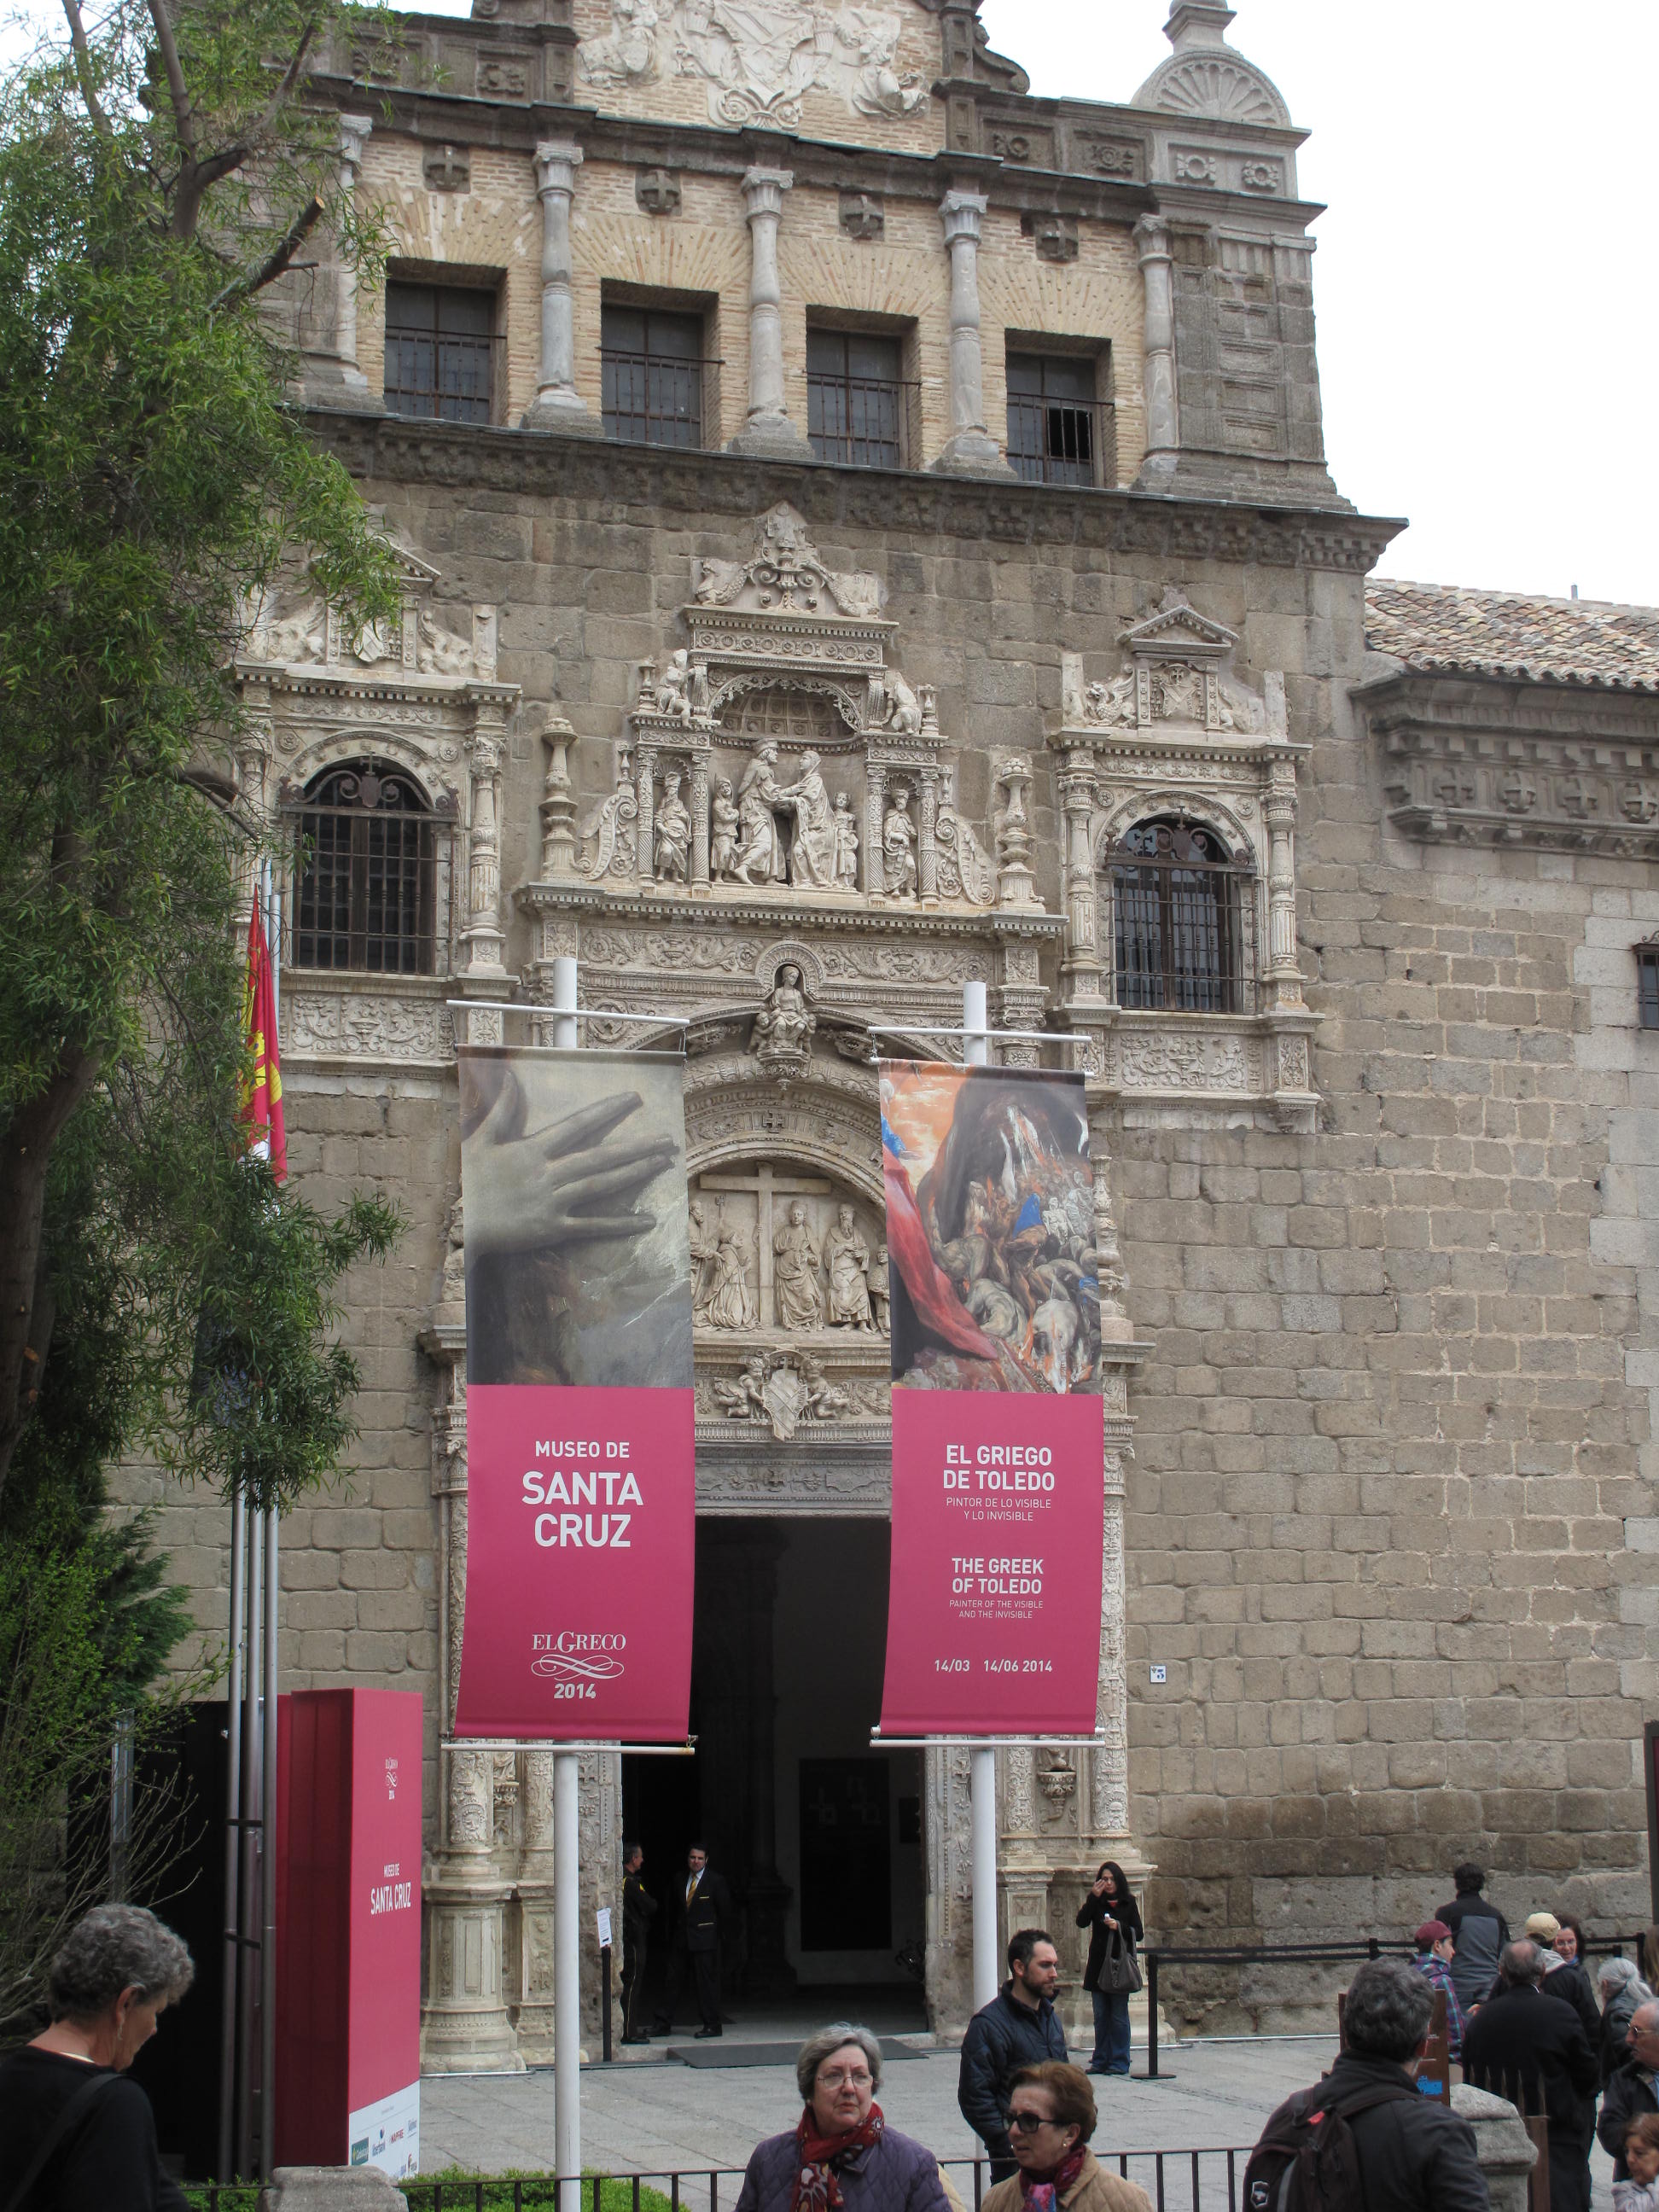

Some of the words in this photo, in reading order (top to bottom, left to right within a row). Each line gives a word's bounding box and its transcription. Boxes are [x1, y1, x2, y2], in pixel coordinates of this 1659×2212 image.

[536, 1441, 601, 1458] MUSEO
[606, 1441, 630, 1458] DE
[947, 1444, 972, 1464] EL
[976, 1445, 1052, 1466] GRIEGO
[521, 1470, 644, 1506] SANTA
[943, 1470, 970, 1490] DE
[975, 1470, 1055, 1492] TOLEDO
[946, 1497, 982, 1508] PINTOR
[985, 1498, 998, 1509] DE
[1000, 1498, 1013, 1509] LO
[1015, 1498, 1051, 1510] VISIBLE
[963, 1510, 970, 1520] Y
[972, 1510, 985, 1521] LO
[987, 1511, 1033, 1522] INVISIBLE
[534, 1513, 631, 1547] CRUZ
[952, 1557, 985, 1574] THE
[988, 1557, 1044, 1575] GREEK
[952, 1577, 975, 1594] OF
[979, 1578, 1042, 1594] TOLEDO
[949, 1599, 983, 1609] PAINTER
[984, 1599, 995, 1609] OF
[996, 1599, 1013, 1610] THE
[1014, 1600, 1044, 1610] VISIBLE
[958, 1610, 976, 1619] AND
[977, 1610, 994, 1620] THE
[995, 1610, 1033, 1620] INVISIBLE
[934, 1658, 970, 1673] 14/03
[983, 1658, 1019, 1674] 14/06
[1022, 1660, 1052, 1673] 2014
[553, 1683, 597, 1699] 2014
[370, 1884, 393, 1915] SANTA
[393, 1881, 411, 1911] CRUZ
